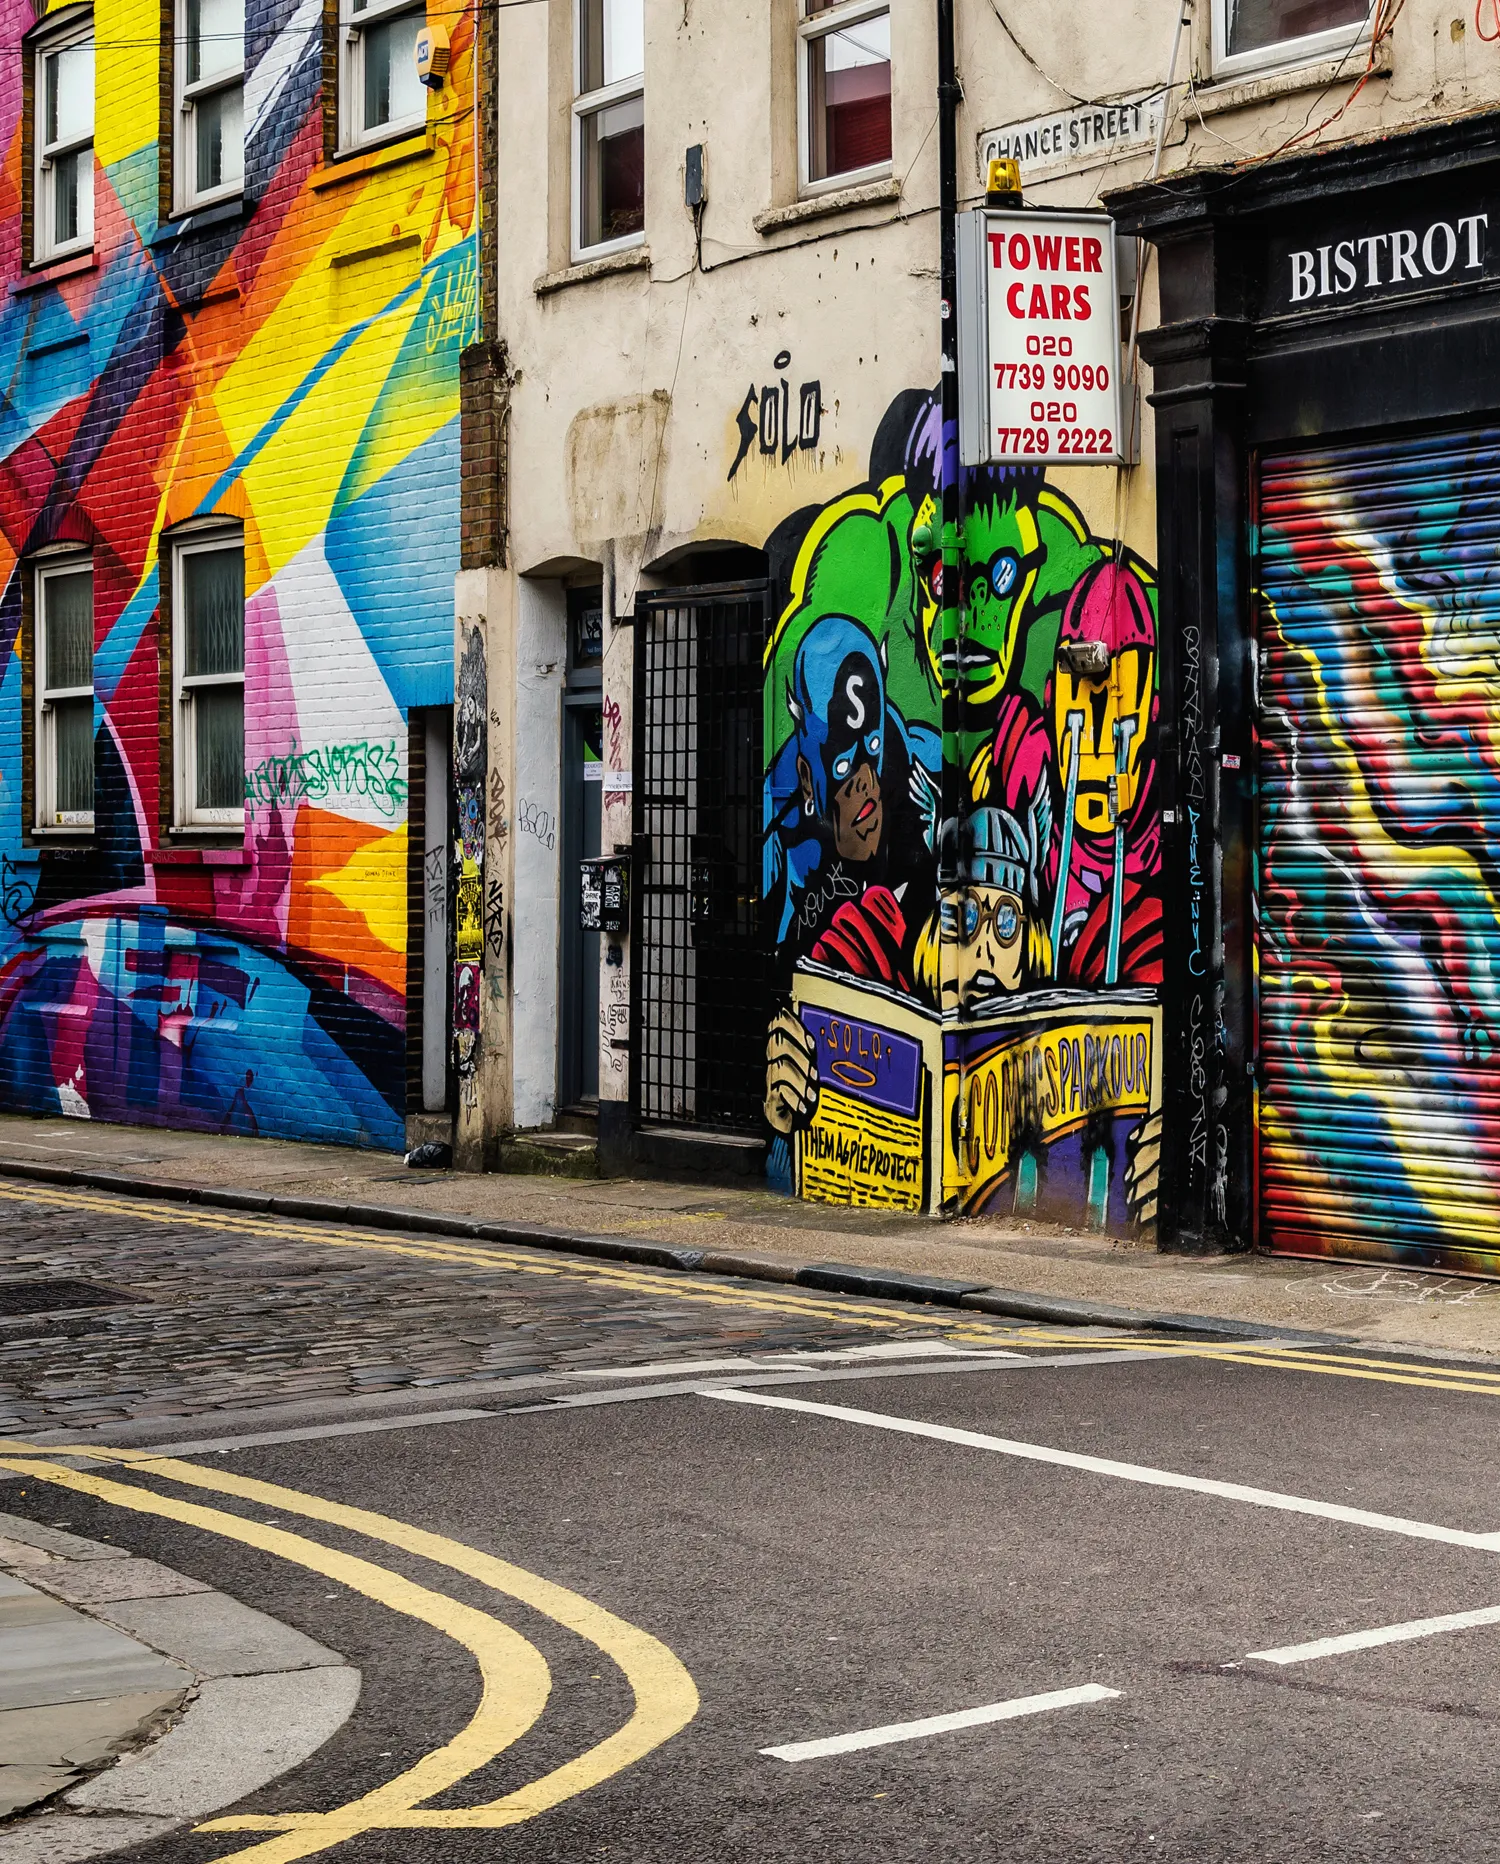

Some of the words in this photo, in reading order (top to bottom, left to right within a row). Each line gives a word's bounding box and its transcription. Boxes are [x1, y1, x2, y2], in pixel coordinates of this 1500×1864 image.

[986, 124, 1063, 163] CHANCE
[1069, 105, 1140, 150] STREET
[987, 232, 1104, 273] TOWER
[1288, 212, 1489, 303] BISTROT
[1006, 282, 1092, 321] CARS
[1026, 335, 1073, 357] 020
[993, 363, 1045, 390] 7739
[1053, 364, 1109, 391] 9090
[1030, 401, 1077, 423] 020
[997, 427, 1050, 454] 7729
[1057, 428, 1113, 454] 2222
[846, 674, 865, 729] S
[827, 1020, 882, 1059] SOLO
